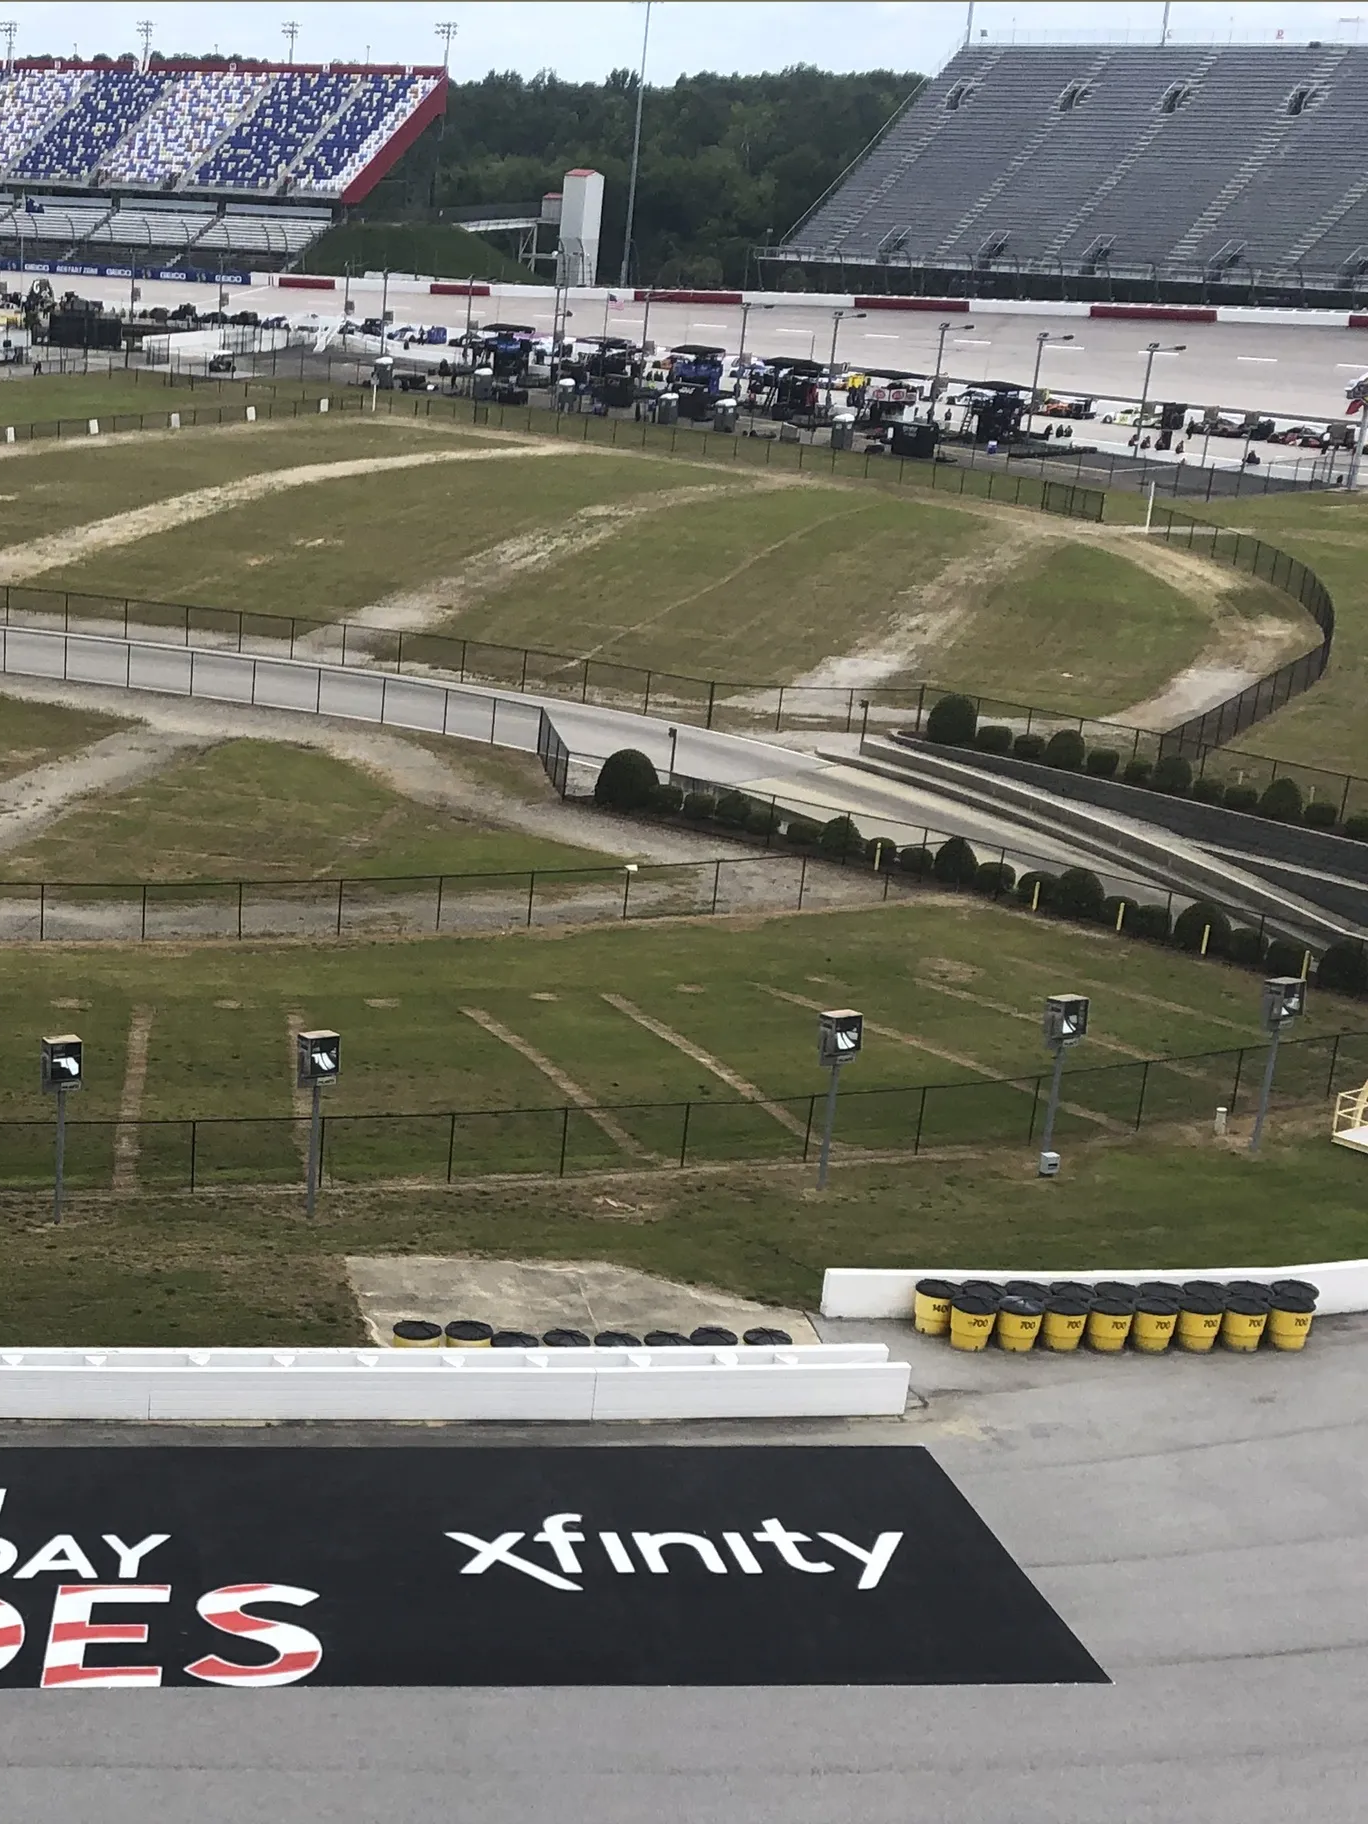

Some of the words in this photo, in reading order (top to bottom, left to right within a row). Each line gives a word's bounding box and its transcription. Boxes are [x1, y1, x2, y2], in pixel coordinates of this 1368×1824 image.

[106, 268, 132, 277] GEICO
[160, 271, 187, 280] GEICO
[1020, 1321, 1036, 1329] 700
[1067, 1320, 1082, 1329] 700
[1111, 1321, 1127, 1330] 700
[1155, 1321, 1171, 1330] 700
[1203, 1319, 1218, 1329] 700
[1248, 1319, 1263, 1328] 700
[1294, 1318, 1309, 1327] 700
[444, 1512, 904, 1591] xfinity
